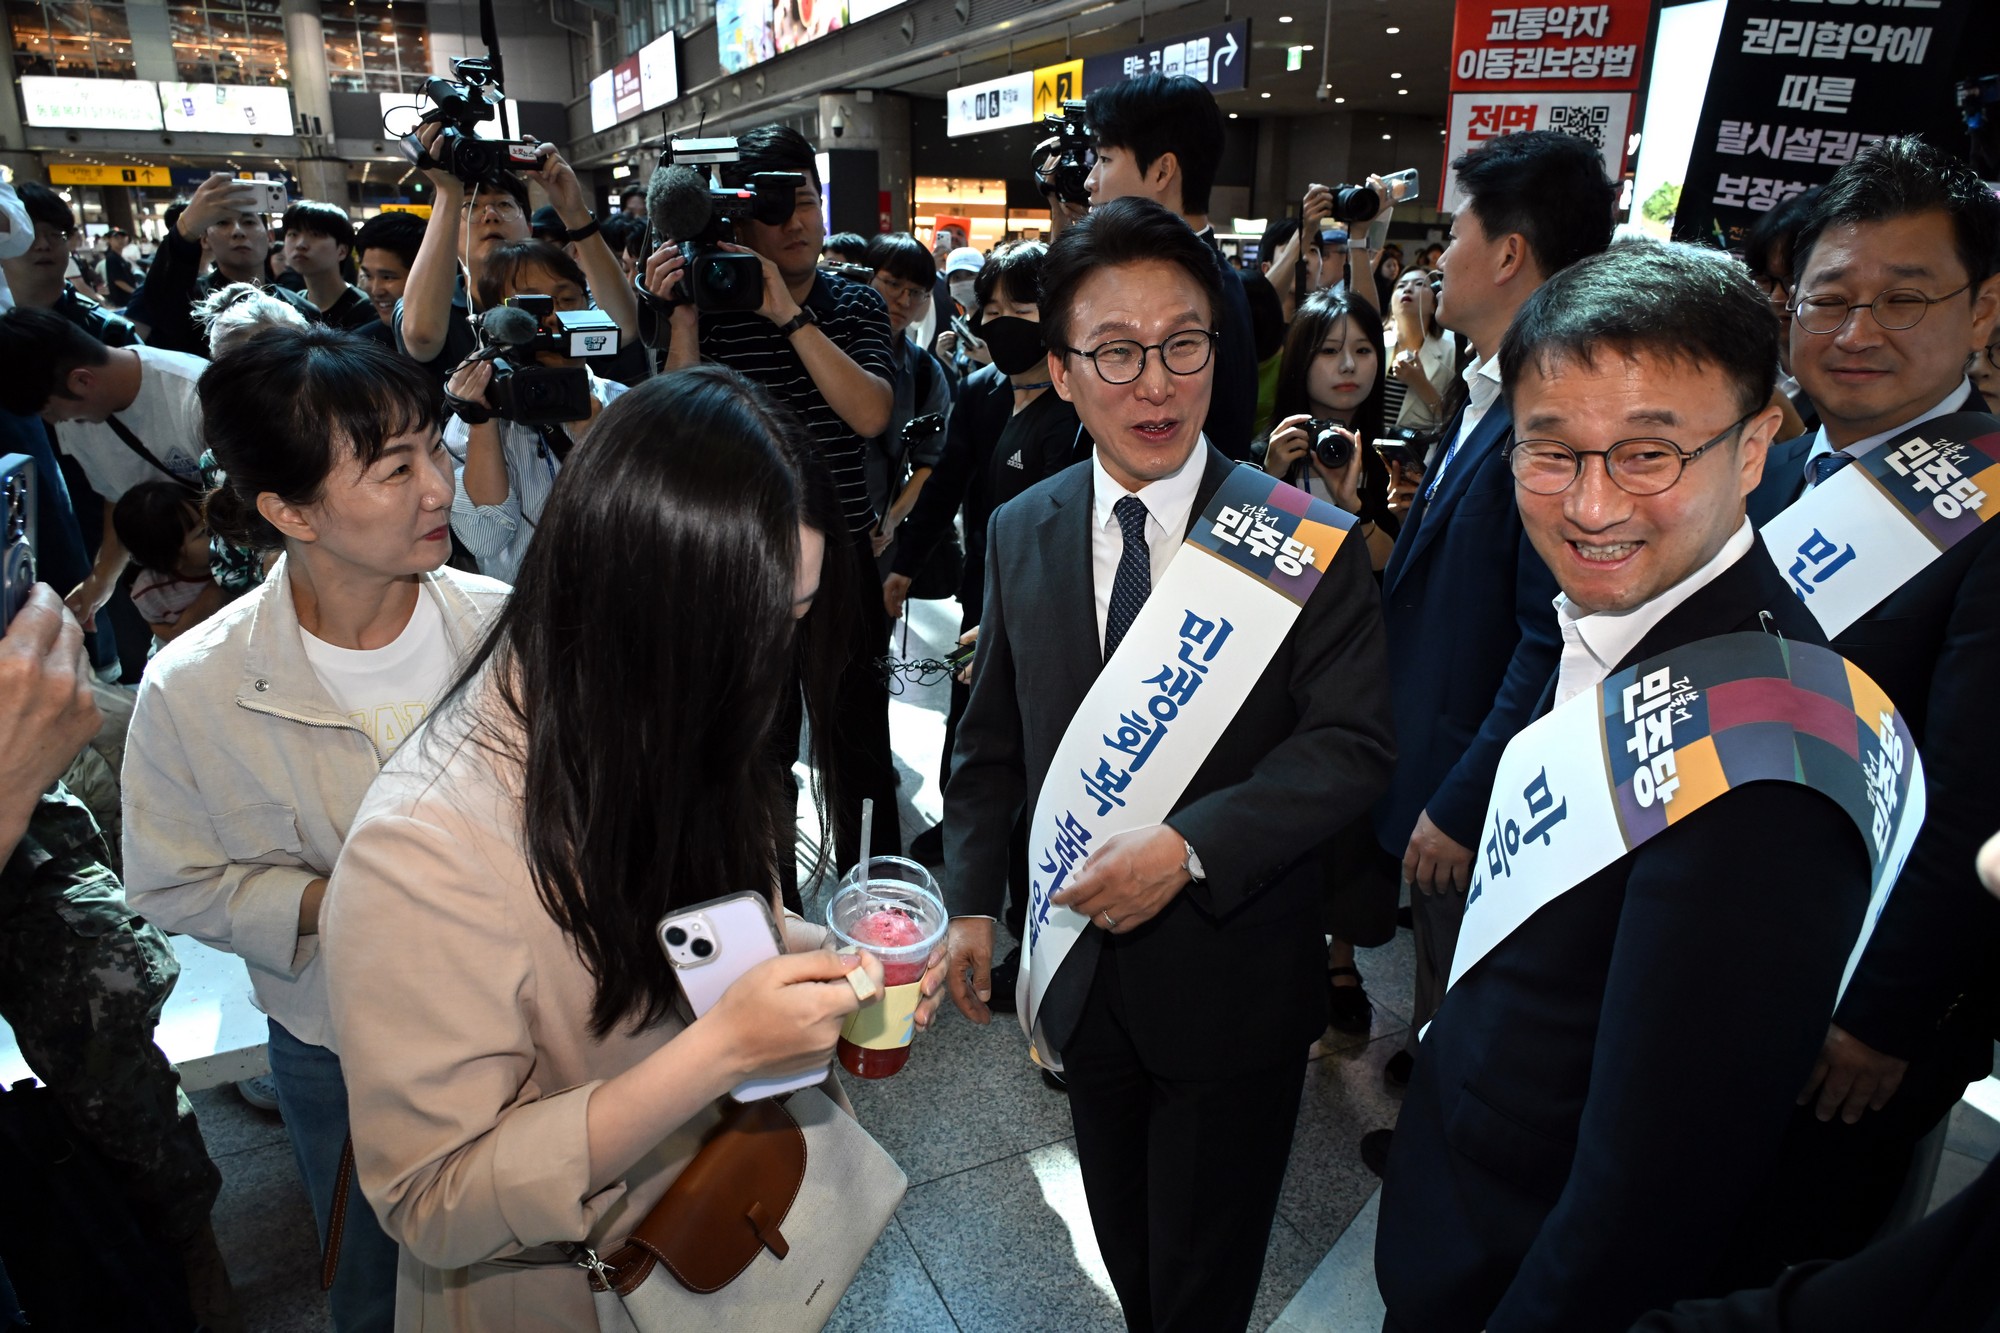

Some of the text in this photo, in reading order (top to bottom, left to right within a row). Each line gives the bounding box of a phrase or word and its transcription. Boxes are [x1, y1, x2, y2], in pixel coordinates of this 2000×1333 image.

[1486, 5, 1609, 41] 교통약자
[1741, 18, 1932, 65] 권리협약에
[1124, 55, 1145, 79] 타는
[1457, 45, 1637, 80] 이동권보장법
[1059, 77, 1069, 103] 2
[1777, 74, 1856, 114] 따른
[1467, 104, 1539, 141] 전면
[512, 148, 535, 158] 노컷뉴스
[1006, 459, 1024, 470] adidas
[1932, 438, 1970, 465] 더불어
[1884, 436, 1987, 519] 민주당
[1241, 503, 1279, 528] 더불어
[1210, 505, 1315, 577] 민주당
[1788, 528, 1857, 603] 민
[1081, 609, 1234, 817] 민생회복
[1670, 676, 1700, 725] 더불어
[1623, 666, 1680, 808] 민주당
[1872, 710, 1904, 863] 민주당
